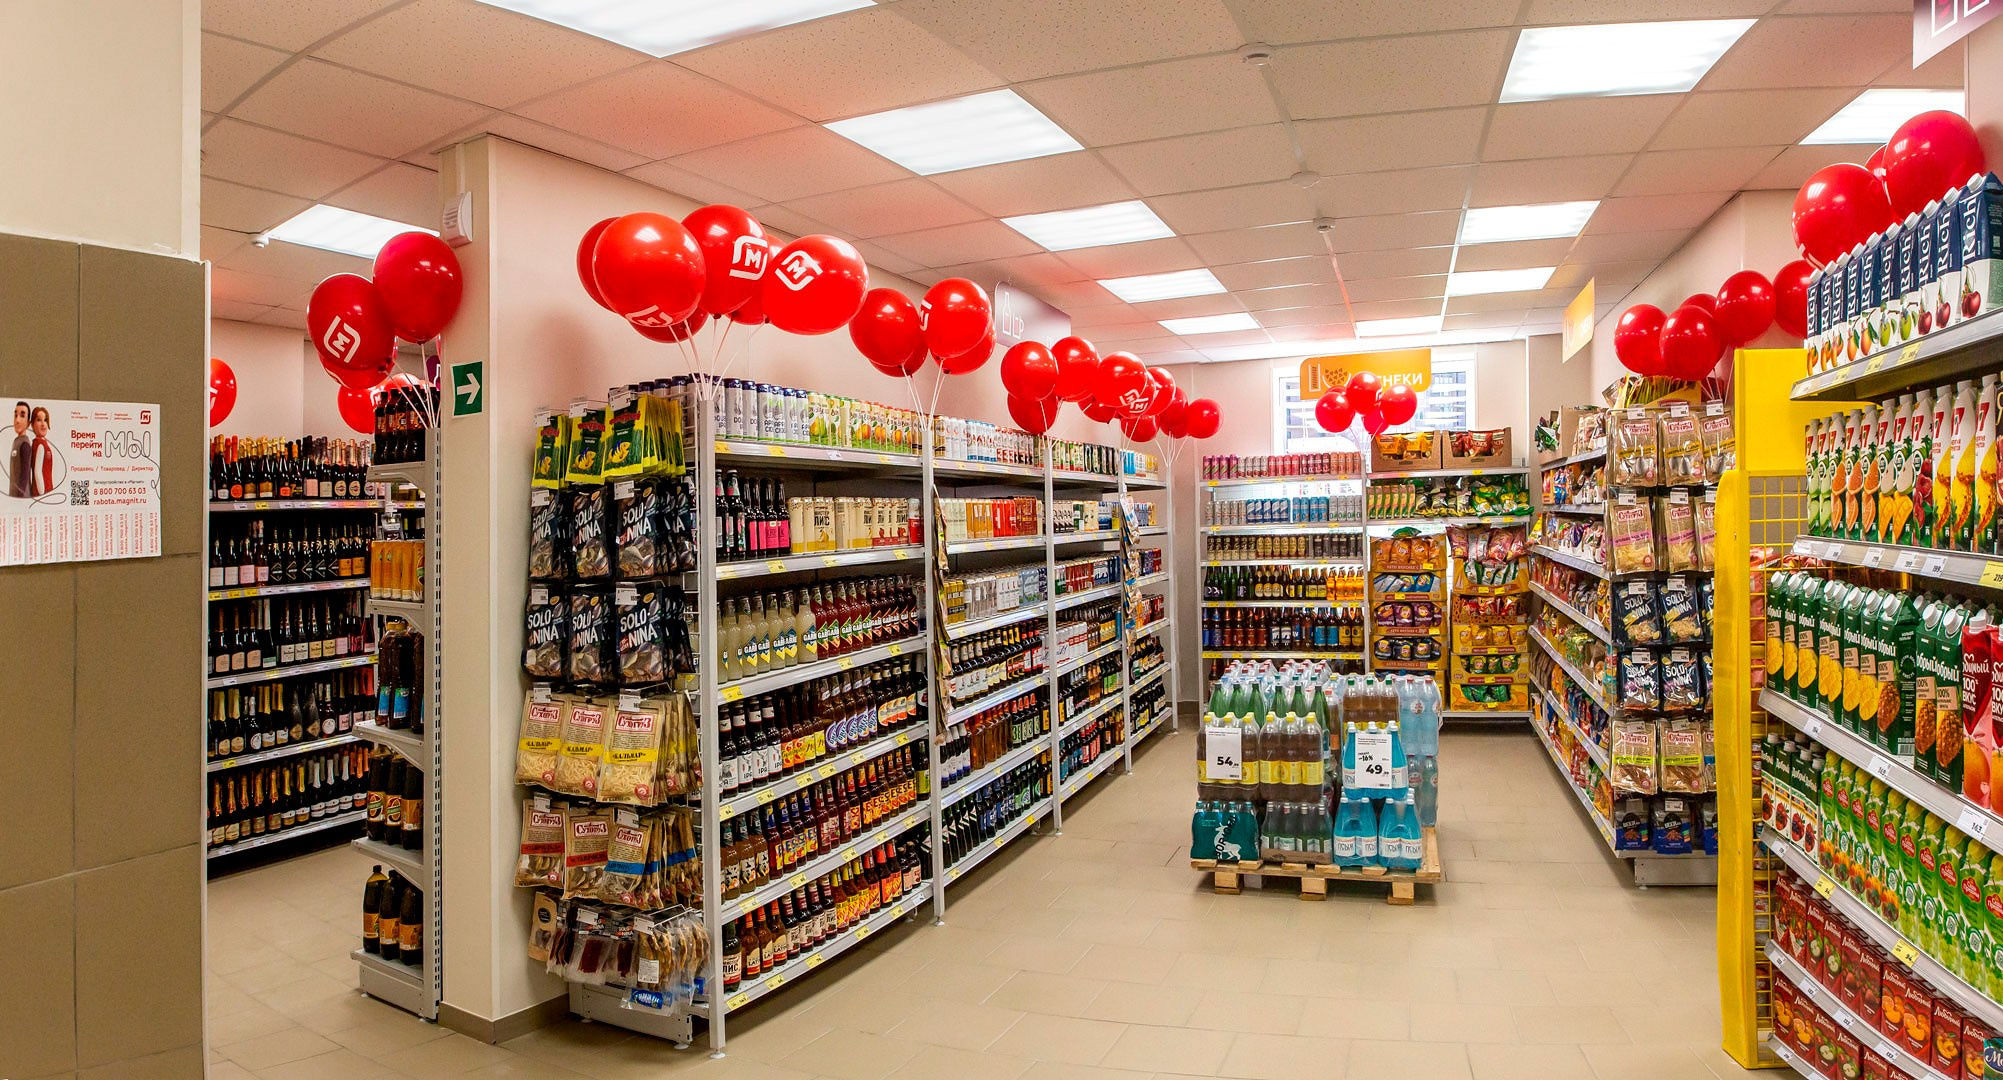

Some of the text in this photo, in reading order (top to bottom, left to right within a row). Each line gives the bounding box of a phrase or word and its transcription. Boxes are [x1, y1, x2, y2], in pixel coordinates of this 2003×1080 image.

[1963, 197, 1977, 261] Rich
[1920, 223, 1931, 285] Rich
[1938, 212, 1951, 272] Rich
[1881, 245, 1893, 300] Rich
[1901, 235, 1912, 293] Rich
[1848, 264, 1858, 317] Rich
[1861, 254, 1872, 310] Rich
[1821, 280, 1830, 331] Rich
[1833, 272, 1842, 321] Rich
[1808, 288, 1816, 335] Rich
[71, 430, 95, 440] Время
[71, 441, 102, 450] перейти
[105, 430, 151, 459] МЫ
[129, 487, 137, 495] 63
[137, 487, 146, 495] 03
[623, 502, 644, 526] SOLO
[814, 515, 830, 526] ЛИС
[627, 517, 651, 542] NINA
[1666, 592, 1684, 606] SOLO
[528, 609, 551, 629] SOLO
[573, 611, 591, 631] SOLO
[621, 608, 646, 632] SOLO
[533, 625, 559, 645] NINA
[628, 623, 657, 648] NINA
[1905, 988, 1931, 1008] Любимый
[1934, 1006, 1961, 1026] Любимый
